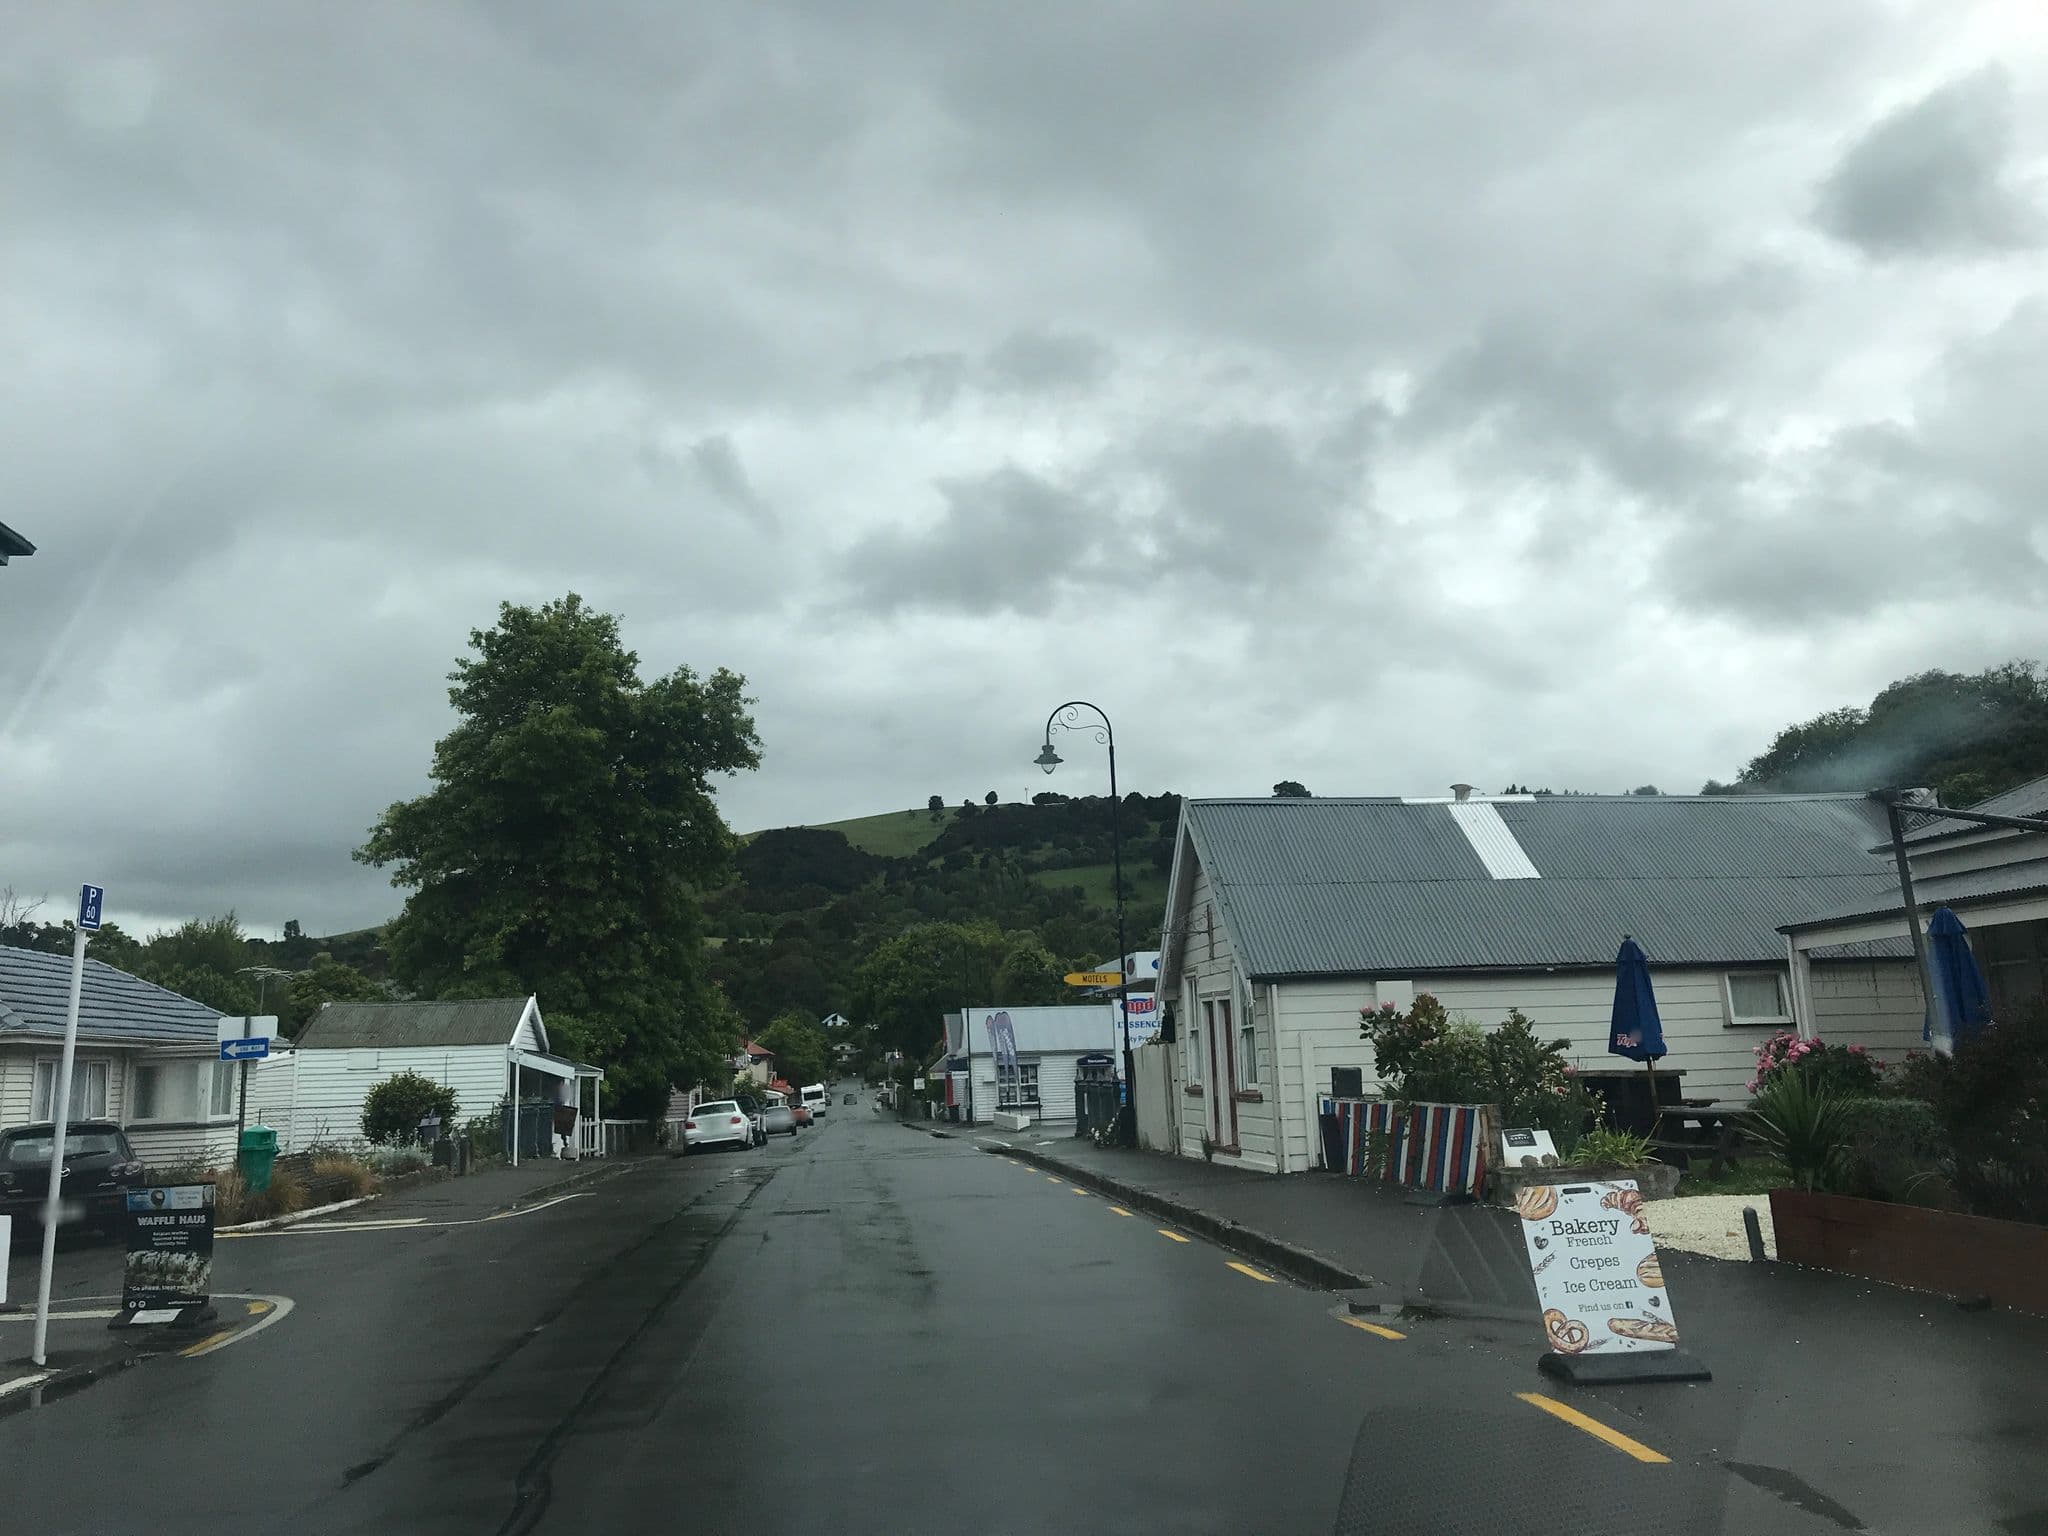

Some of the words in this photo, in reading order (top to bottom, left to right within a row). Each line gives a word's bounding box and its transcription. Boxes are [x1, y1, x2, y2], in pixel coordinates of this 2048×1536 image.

[89, 888, 97, 904] P
[86, 905, 96, 919] 60
[1082, 975, 1108, 983] MOTELS
[1117, 1020, 1162, 1029] L'SSENCE
[137, 1216, 175, 1226] WAFFLE
[179, 1215, 206, 1224] HAUS
[1549, 1219, 1620, 1236] Bakery
[1567, 1235, 1613, 1247] French
[1570, 1256, 1620, 1270] Crepes
[1563, 1281, 1586, 1294] Ice
[1589, 1278, 1638, 1292] Cream
[1578, 1304, 1599, 1312] Find
